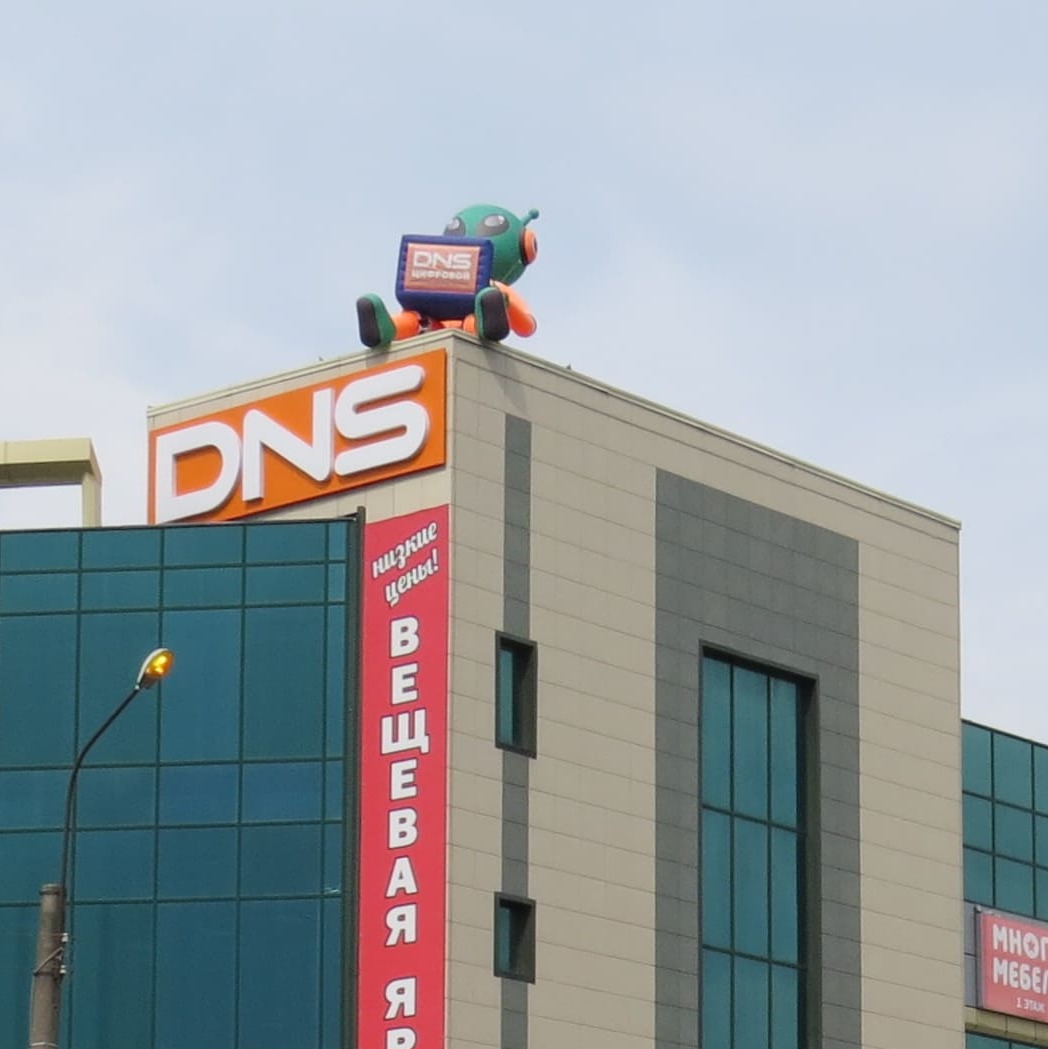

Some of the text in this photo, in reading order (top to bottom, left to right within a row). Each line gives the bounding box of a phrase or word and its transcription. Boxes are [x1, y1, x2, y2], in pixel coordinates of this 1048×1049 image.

[413, 251, 472, 270] DNS
[155, 364, 430, 525] DNS
[371, 522, 438, 579] низкие
[383, 548, 440, 608] цены!
[380, 615, 430, 947] ВЕЩЕВАЯ
